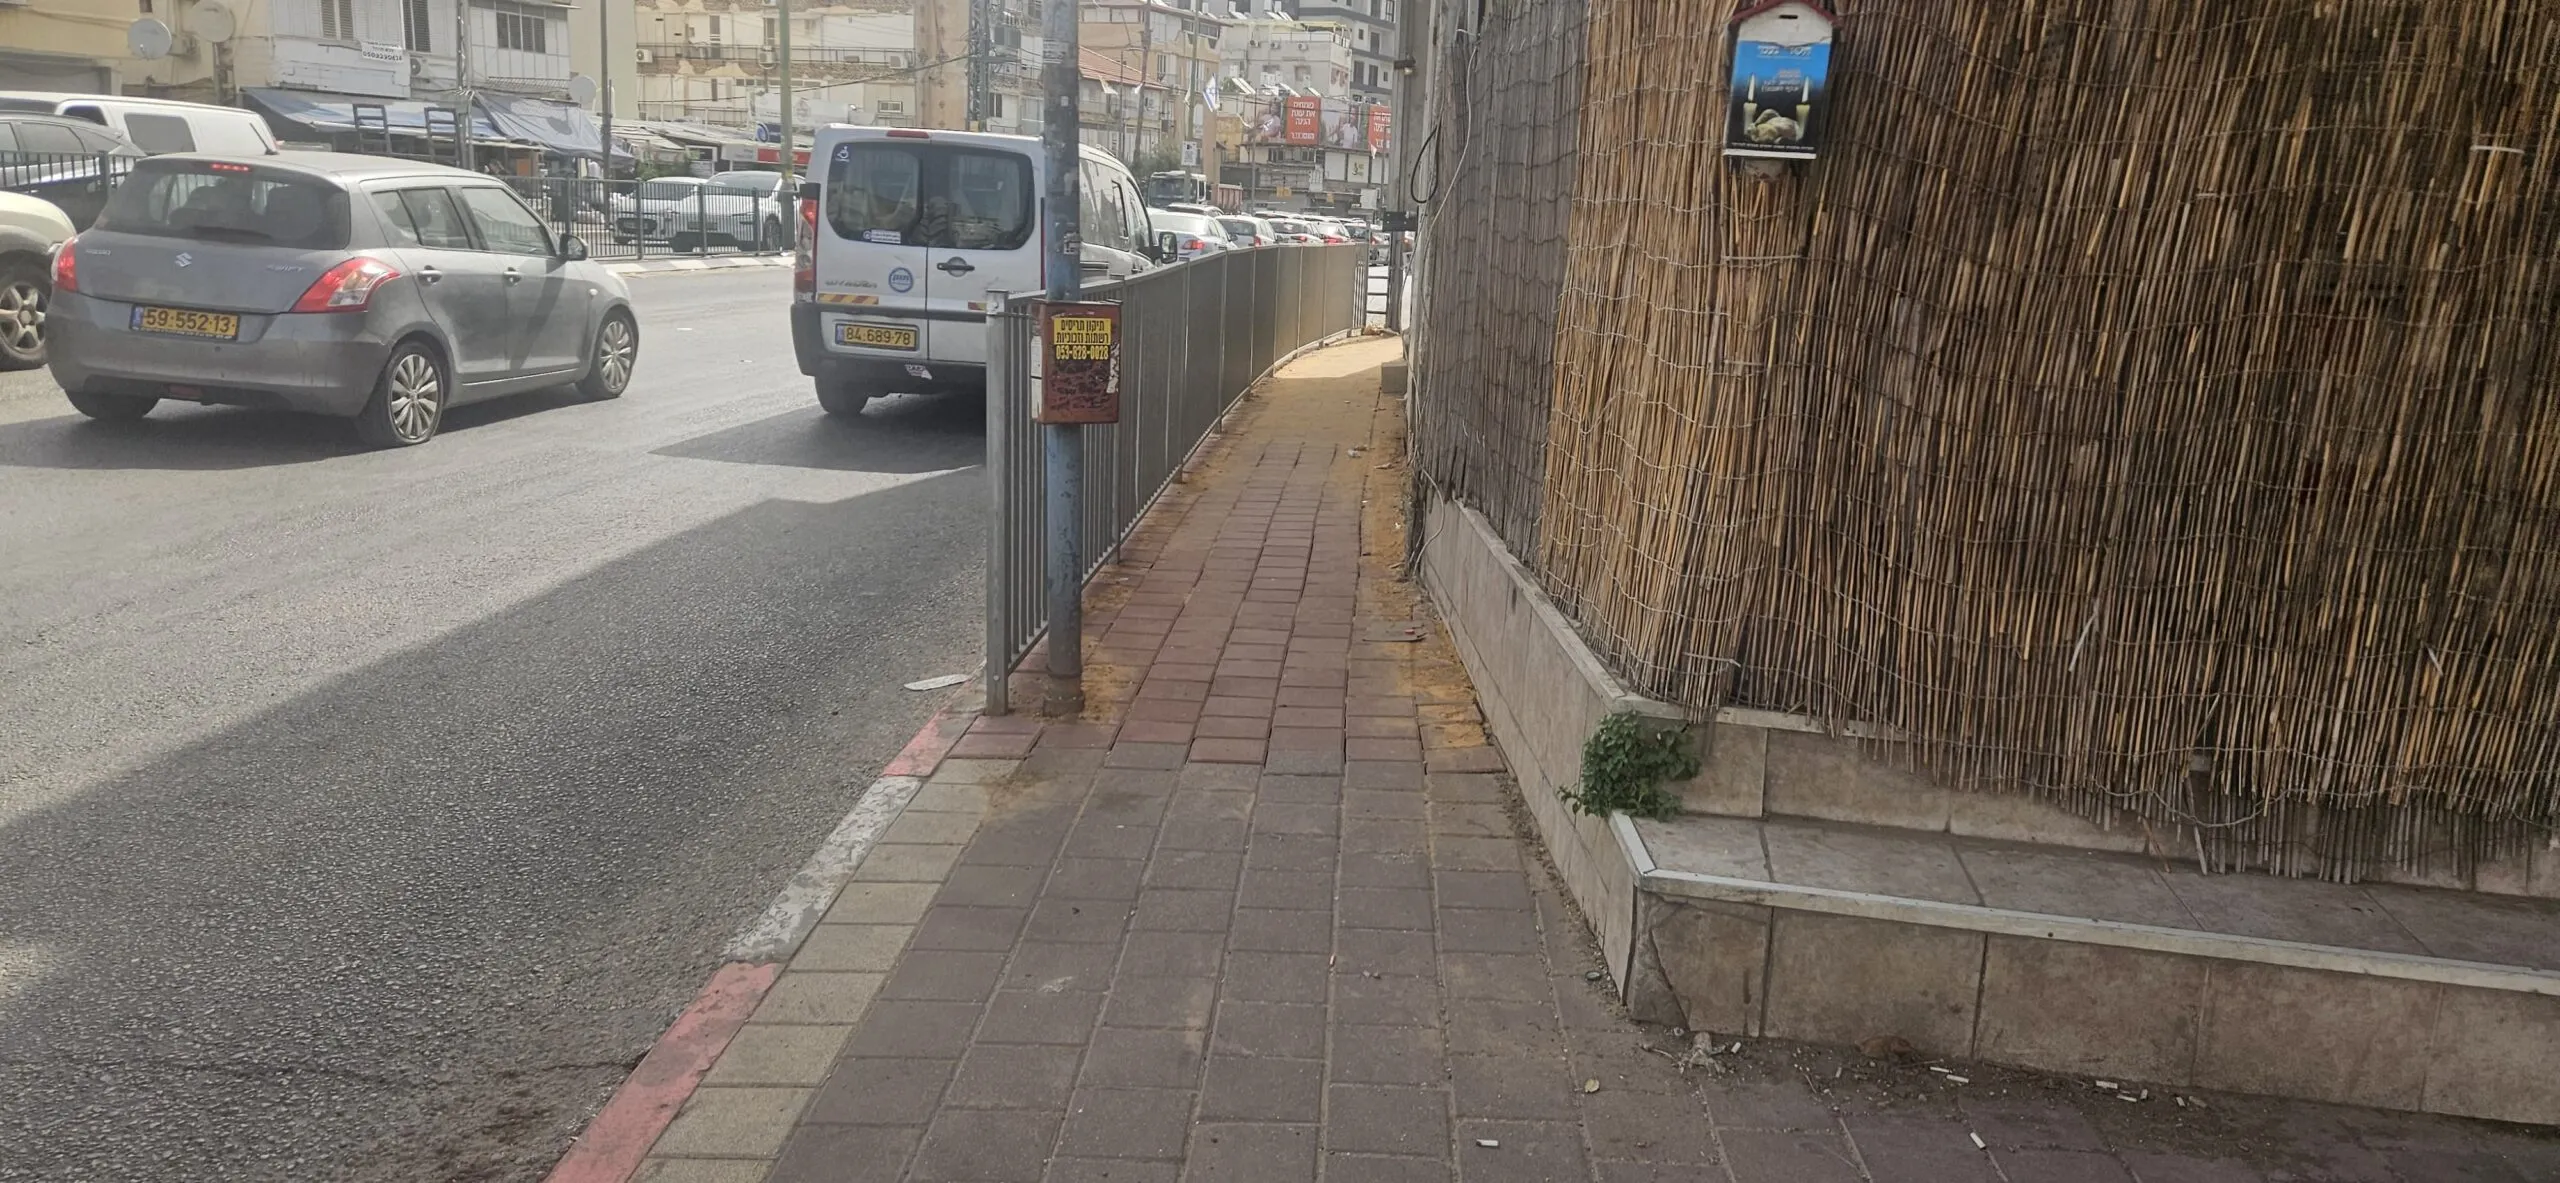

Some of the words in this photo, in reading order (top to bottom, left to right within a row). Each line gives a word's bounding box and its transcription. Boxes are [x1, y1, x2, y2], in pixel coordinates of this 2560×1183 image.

[1061, 320, 1085, 331] תריסים
[1086, 320, 1104, 332] תיקון
[1085, 332, 1109, 344] רשתות
[1056, 345, 1109, 360] 053-828-0028
